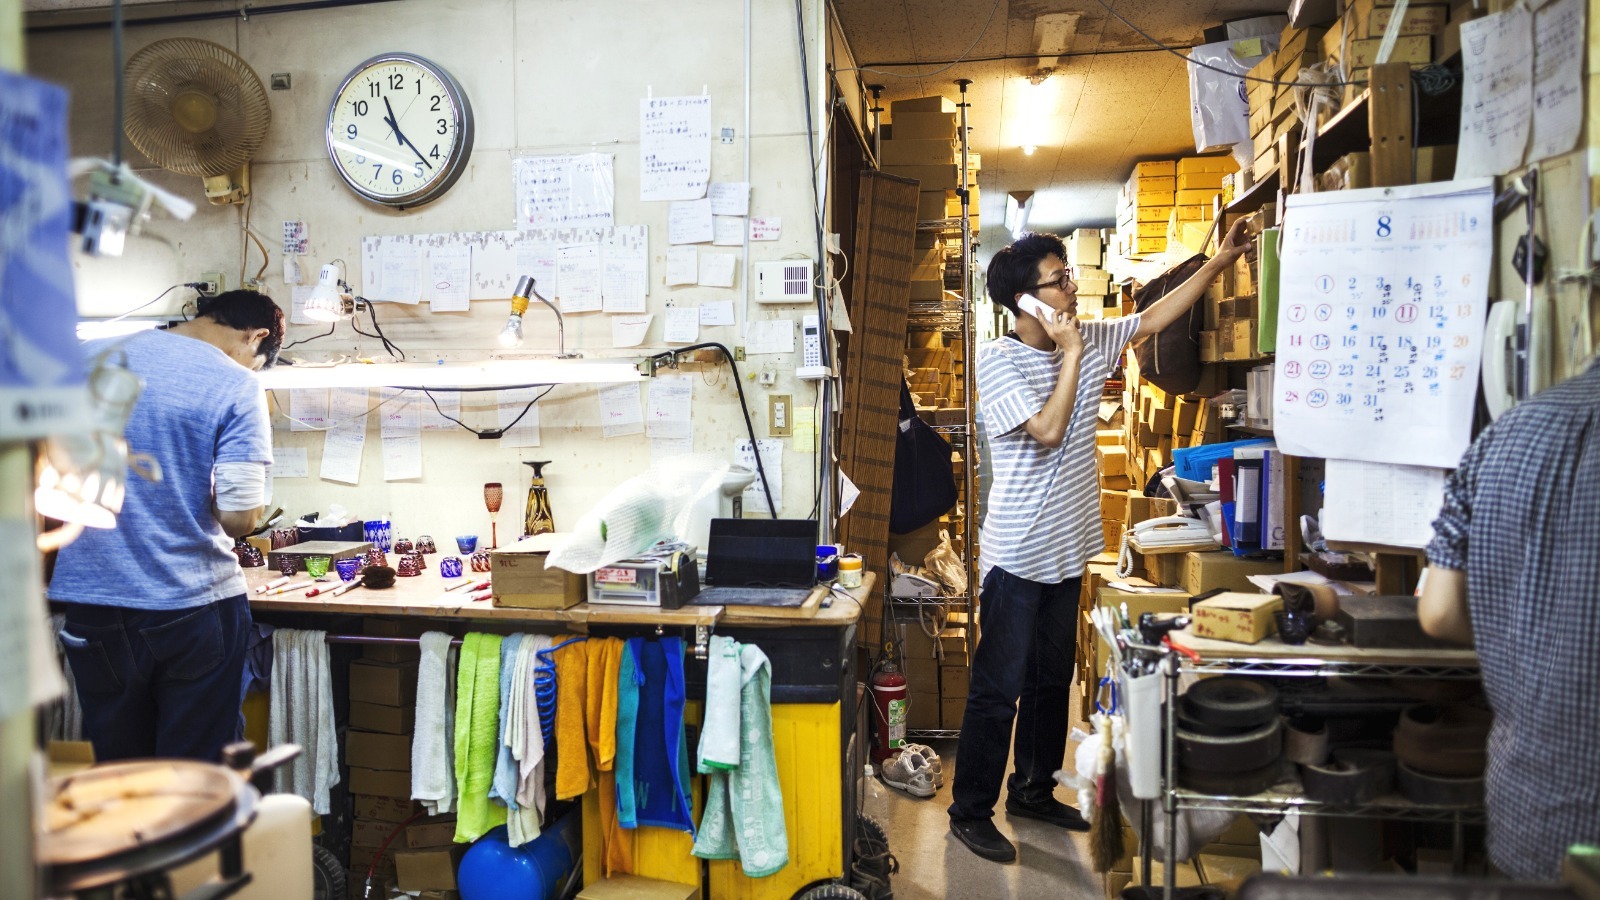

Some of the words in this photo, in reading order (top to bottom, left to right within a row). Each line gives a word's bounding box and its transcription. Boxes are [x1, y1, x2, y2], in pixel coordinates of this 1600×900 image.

[369, 81, 380, 97] 11
[388, 74, 403, 90] 12
[416, 79, 421, 94] 1
[352, 100, 368, 116] 10
[430, 95, 441, 111] 2
[347, 124, 358, 139] 9
[437, 119, 447, 135] 3
[430, 144, 440, 160] 4
[372, 164, 382, 180] 7
[392, 169, 403, 185] 6
[414, 162, 423, 178] 5
[1376, 215, 1392, 238] 8
[1470, 217, 1478, 228] 9
[1322, 278, 1328, 290] 1
[1349, 278, 1356, 289] 2
[1376, 277, 1384, 288] 3
[1405, 276, 1412, 288] 4
[1434, 275, 1441, 288] 5
[1462, 274, 1470, 286] 6
[1294, 306, 1301, 318] 7
[1319, 306, 1327, 318] 8
[1347, 307, 1355, 319] 9
[1372, 307, 1386, 319] 10
[1401, 306, 1414, 319] 11
[1430, 306, 1444, 318] 12
[1457, 304, 1472, 317] 13
[1289, 335, 1302, 346] 14
[1314, 335, 1329, 347] 15
[1342, 335, 1356, 347] 16
[1370, 336, 1384, 347] 17
[1397, 336, 1412, 347] 18
[1426, 336, 1441, 348] 19
[1453, 335, 1469, 348] 20
[1287, 363, 1300, 375] 21
[1312, 364, 1327, 375] 22
[1338, 364, 1354, 376] 23
[1366, 366, 1381, 377] 24
[1394, 366, 1410, 378] 25
[1422, 366, 1438, 379] 26
[1450, 366, 1466, 379] 27
[1285, 391, 1299, 402] 28
[1310, 392, 1325, 403] 29
[1336, 393, 1351, 405] 30
[1364, 394, 1378, 406] 31
